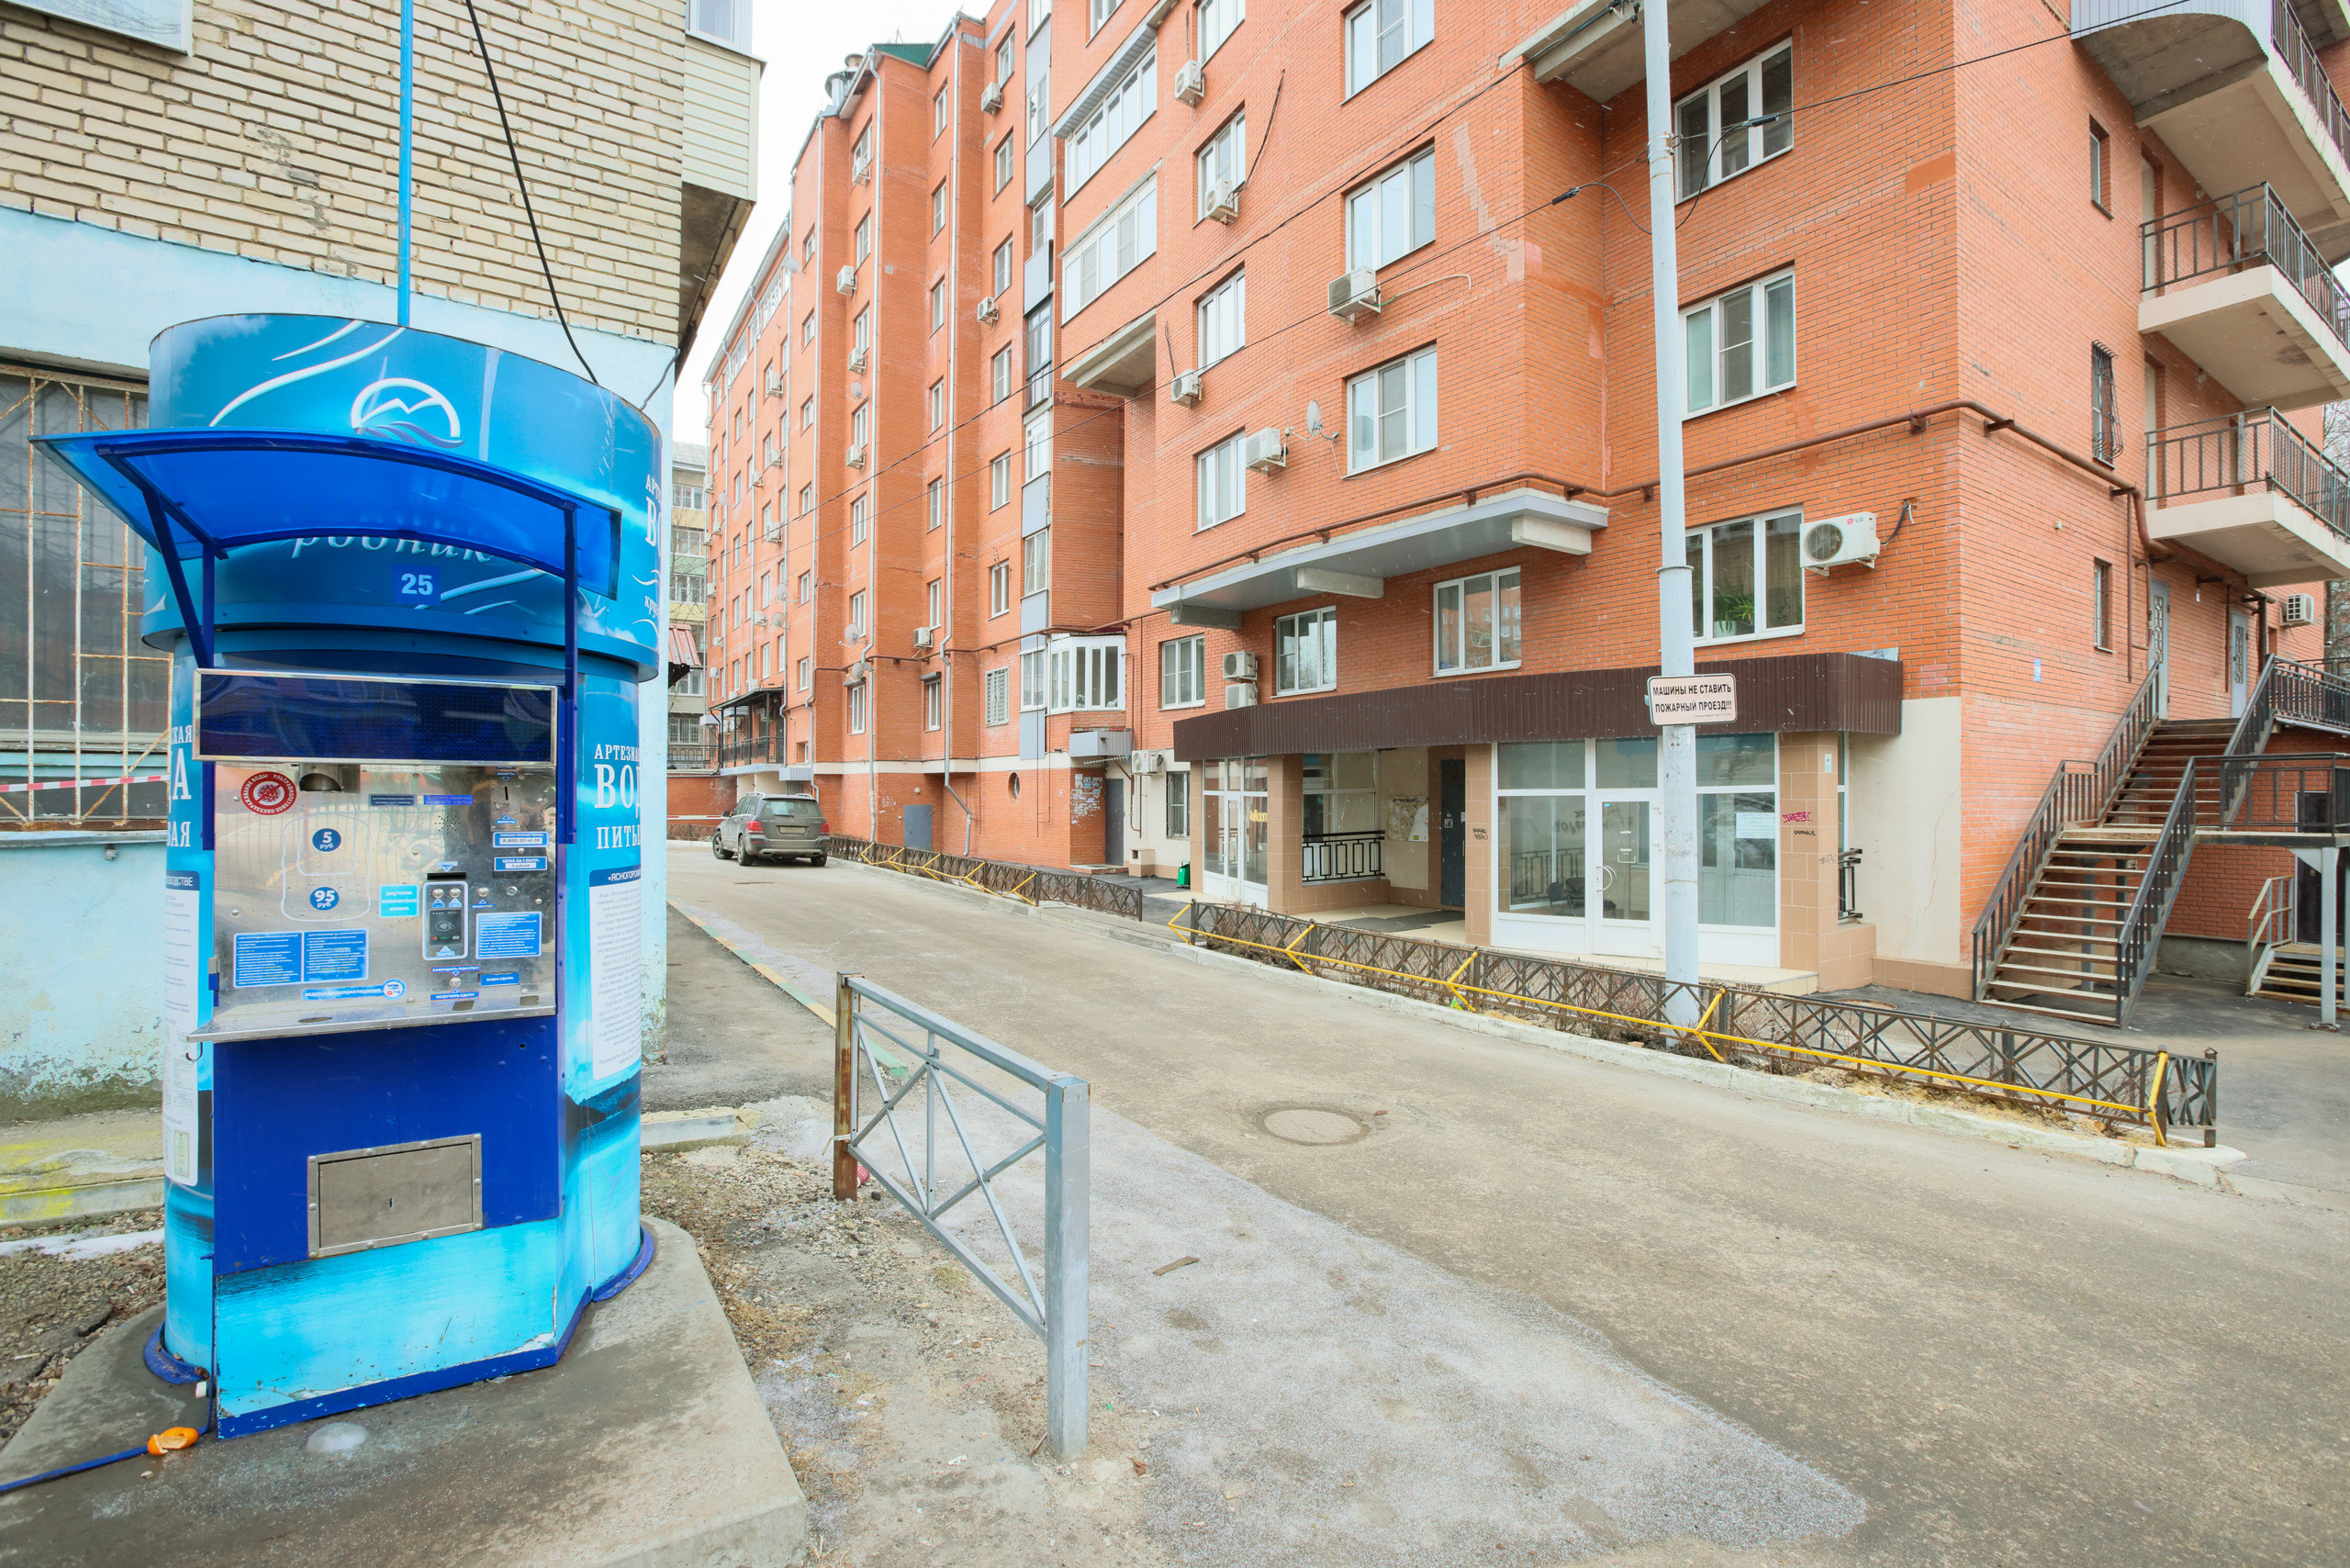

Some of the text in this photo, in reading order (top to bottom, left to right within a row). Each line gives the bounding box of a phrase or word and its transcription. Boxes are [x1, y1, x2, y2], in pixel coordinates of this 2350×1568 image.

[401, 573, 433, 596] 25
[1653, 684, 1731, 696] МАШИНЫ НЕ СТАВИТЬ
[1655, 700, 1732, 712] ПОЖАРНЫЙ ПРОЕЗД!!!
[322, 831, 333, 844] 5
[314, 890, 336, 902] 95
